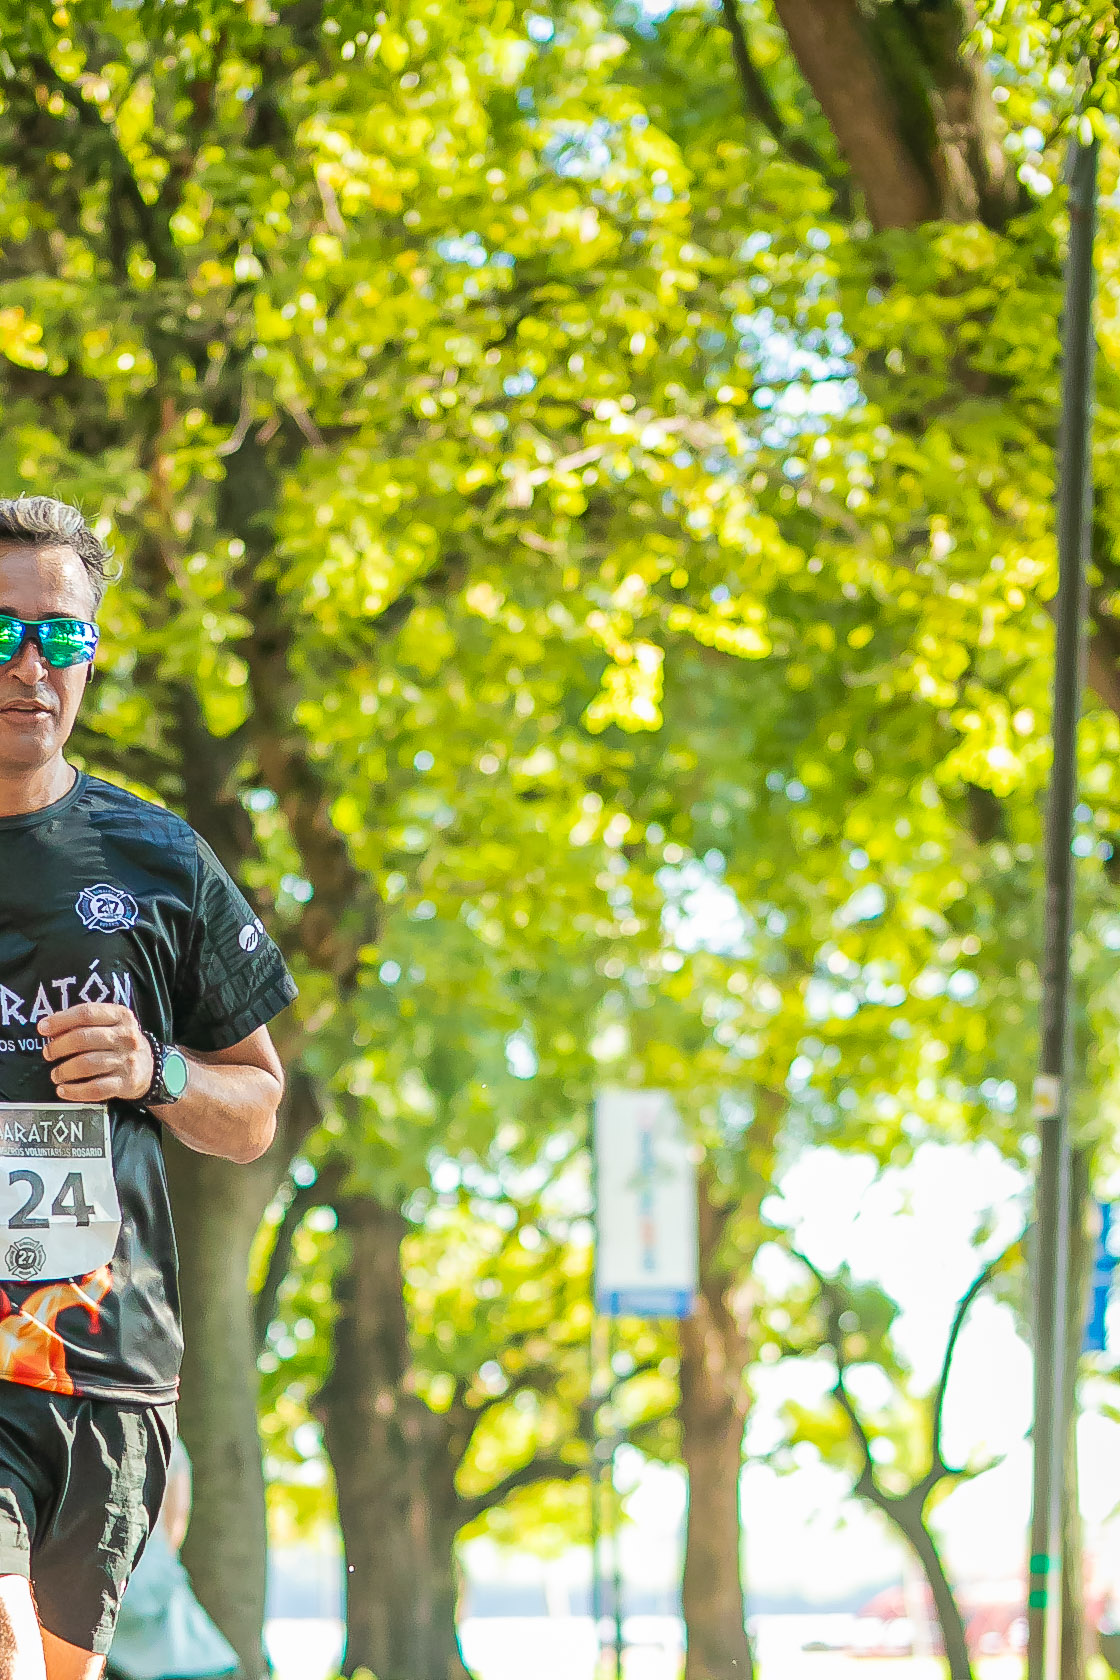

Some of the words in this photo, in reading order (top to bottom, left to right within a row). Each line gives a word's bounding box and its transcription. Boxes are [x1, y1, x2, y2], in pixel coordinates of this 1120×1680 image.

[96, 897, 120, 914] 27
[71, 1147, 103, 1158] ROSARIO
[18, 1250, 35, 1265] 27
